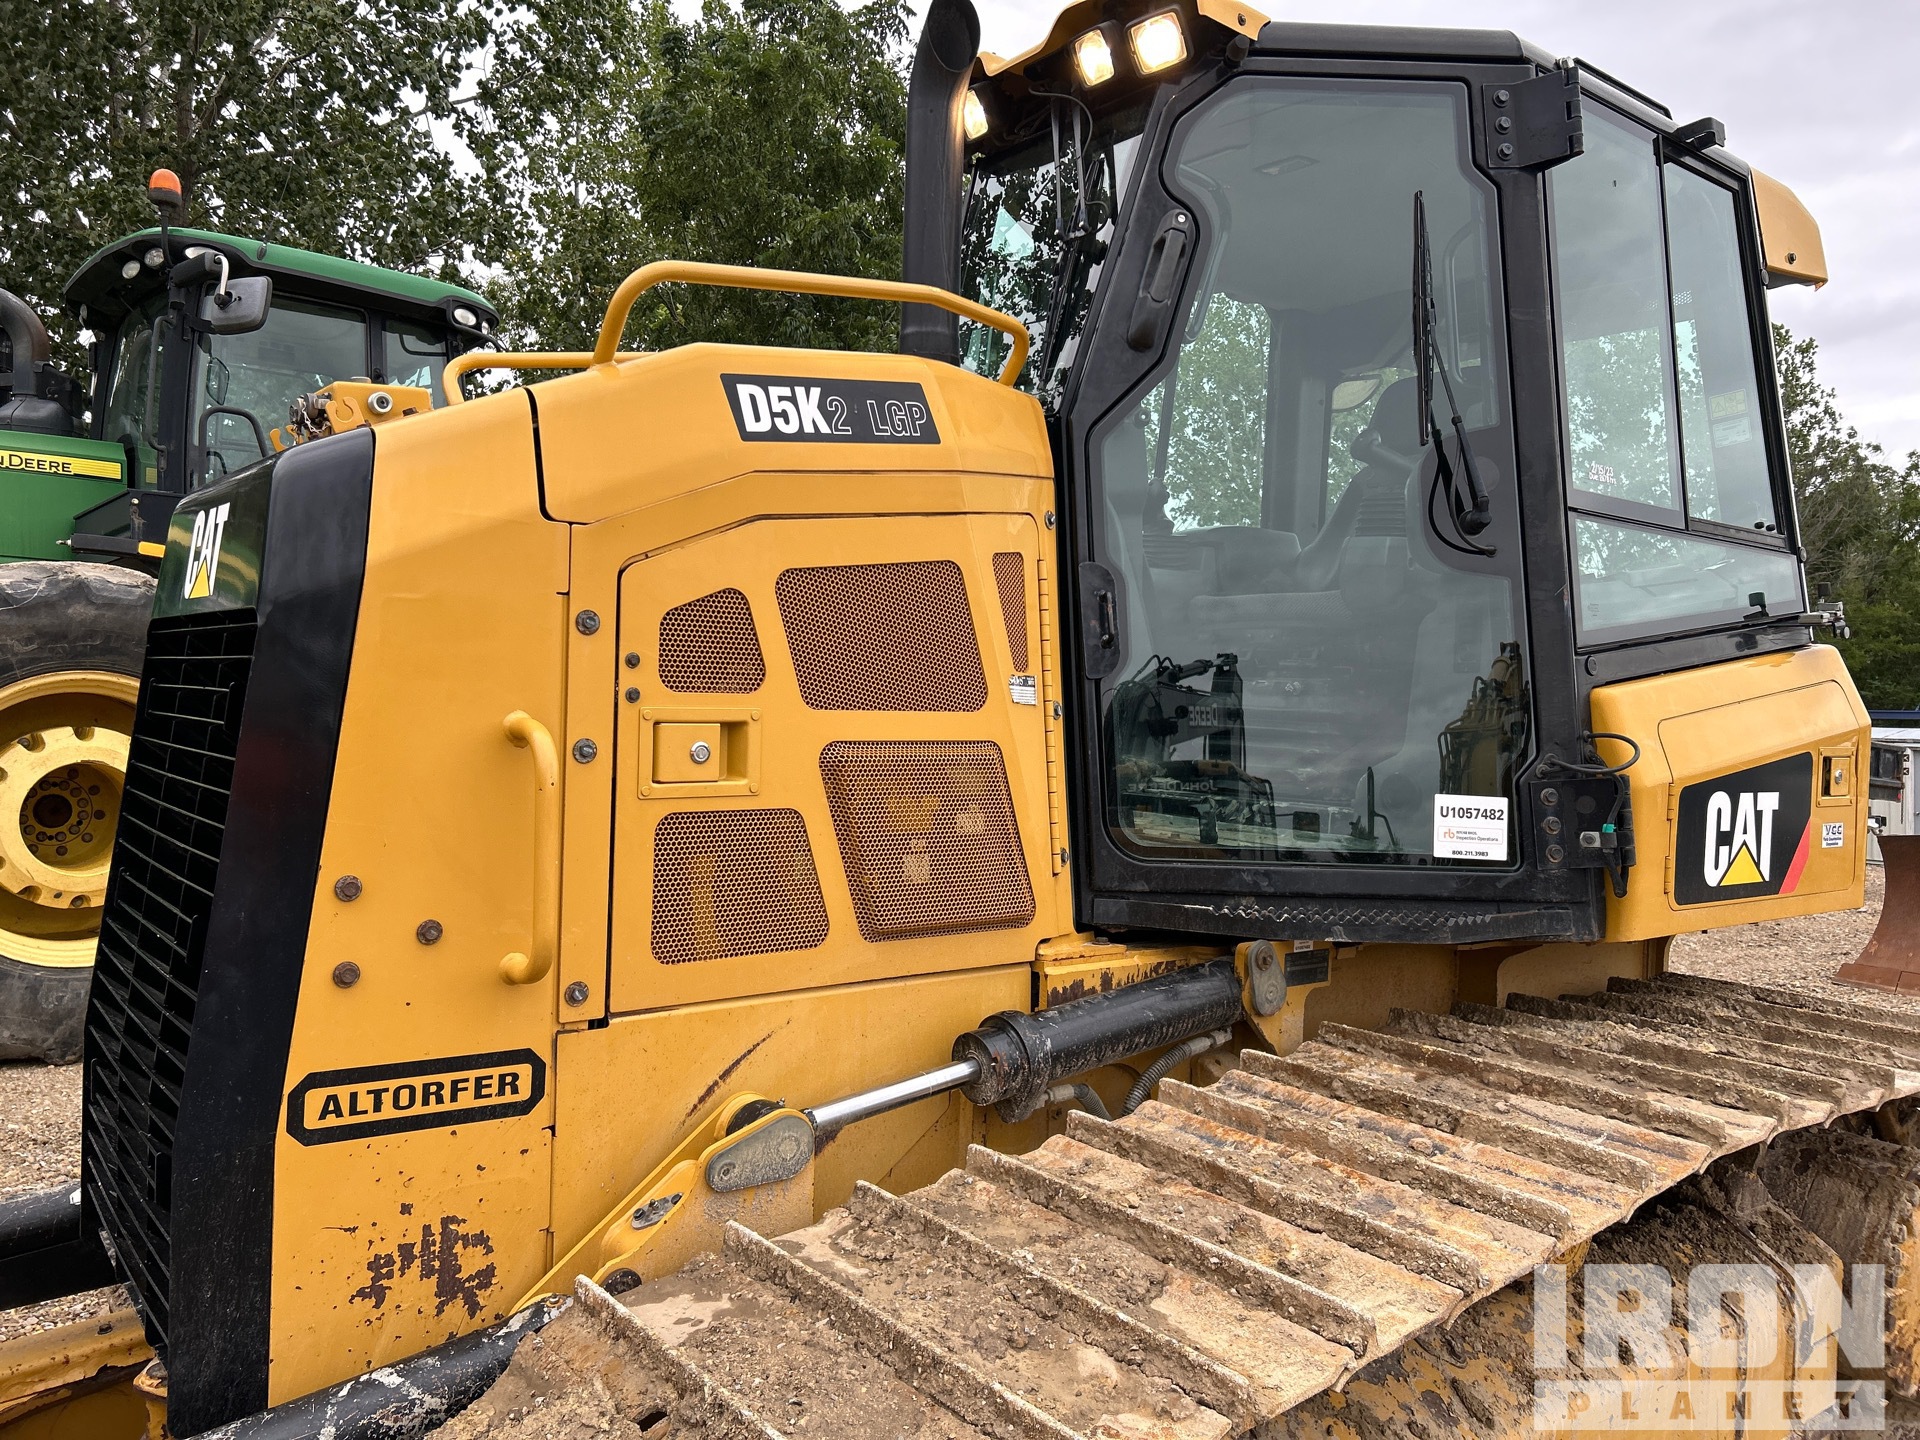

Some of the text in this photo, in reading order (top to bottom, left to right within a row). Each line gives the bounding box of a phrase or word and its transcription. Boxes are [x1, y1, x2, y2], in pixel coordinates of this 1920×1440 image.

[867, 400, 927, 436] LGP
[8, 453, 73, 473] DEERE
[184, 502, 231, 599] CAT
[1440, 806, 1505, 821] U1057482
[1704, 791, 1780, 887] CAT
[318, 1072, 520, 1121] ALTORFER
